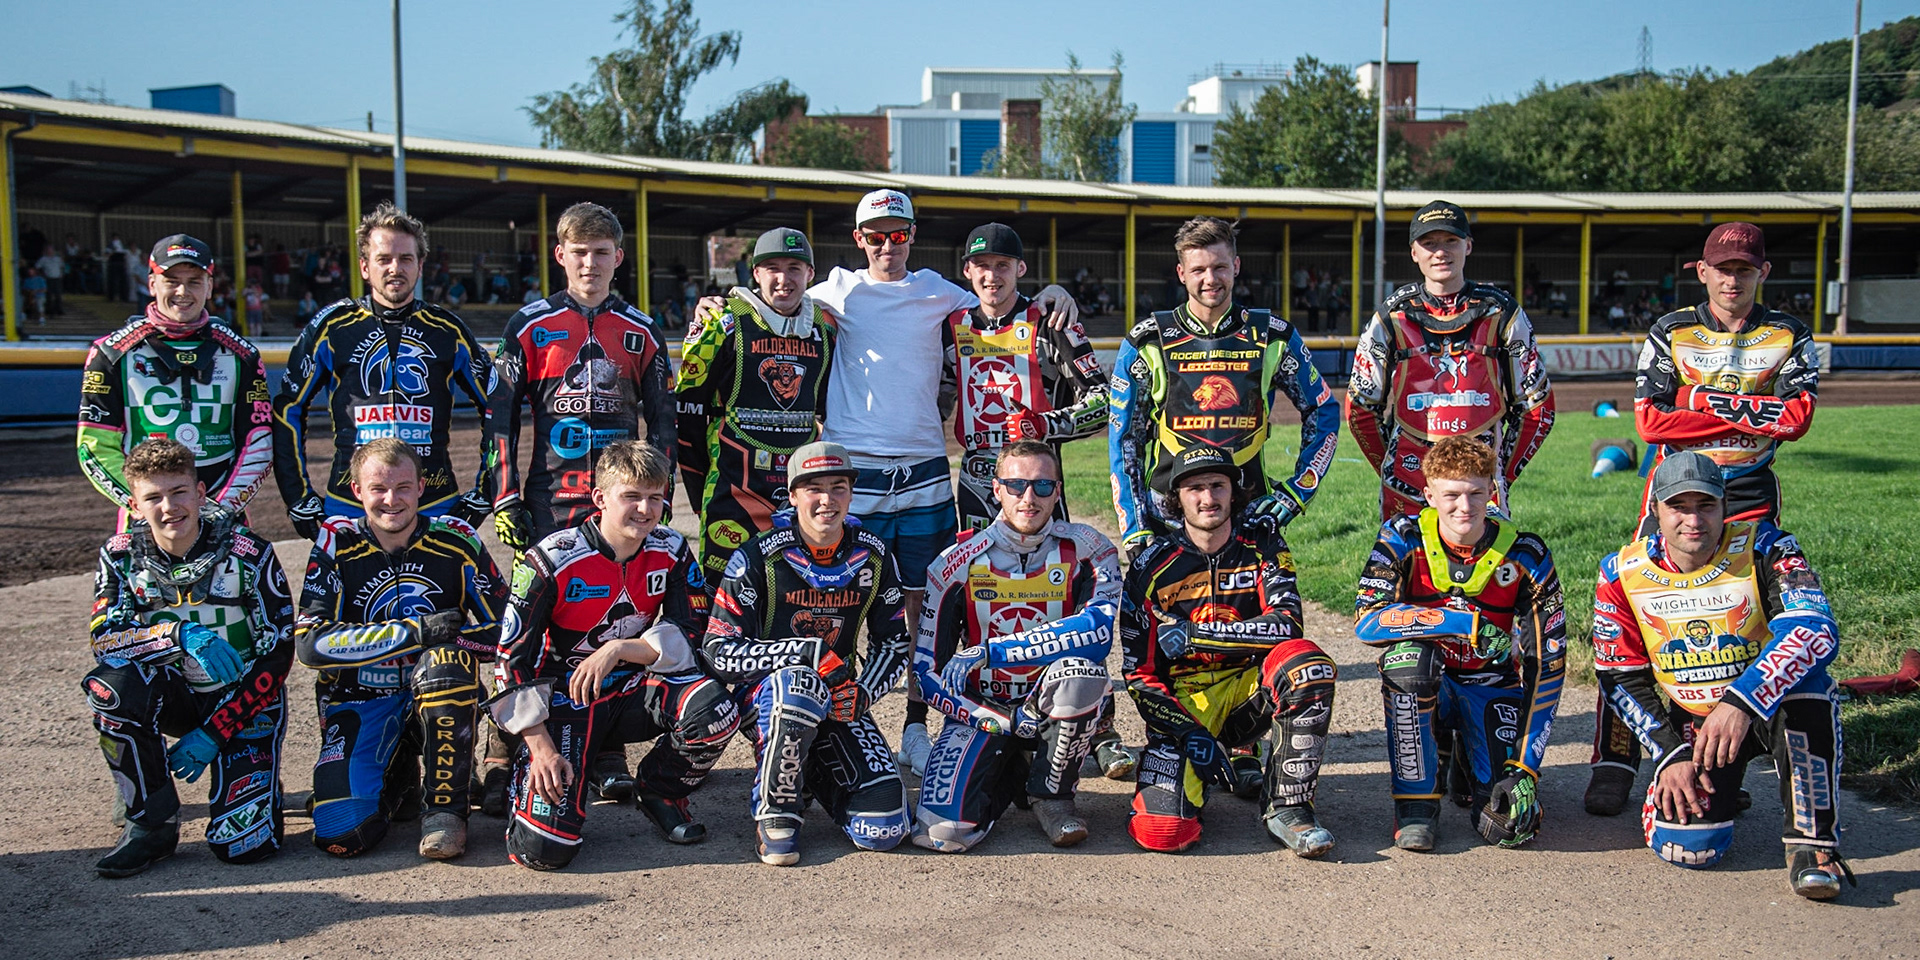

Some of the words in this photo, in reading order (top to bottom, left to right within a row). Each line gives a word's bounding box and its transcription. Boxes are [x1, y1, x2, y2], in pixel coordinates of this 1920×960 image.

[211, 323, 257, 353] cobra's
[1019, 328, 1025, 338] 1
[1692, 329, 1717, 345] ISLE
[1720, 338, 1734, 346] of
[1737, 330, 1773, 347] WIGHT
[751, 337, 818, 358] MILDENHALL
[1170, 351, 1207, 360] ROGER
[1209, 350, 1260, 359] WEBSTER
[1179, 362, 1250, 373] LEICESTER
[1693, 354, 1767, 366] WIGHTLINK
[981, 386, 1005, 396] 2019
[1422, 390, 1491, 408] TouchTec
[357, 406, 433, 423] JARVIS
[1076, 408, 1107, 426] ROCK
[1172, 416, 1215, 430] LION
[1218, 415, 1258, 430] CUBS
[359, 424, 430, 441] nuclear
[1427, 416, 1467, 434] Kings
[1719, 438, 1758, 449] EPOS
[1184, 449, 1222, 460] STAVA
[759, 530, 793, 549] HAGON
[761, 536, 796, 556] SHOCKS
[858, 535, 886, 556] SHOCKS
[859, 530, 885, 549] HAGON
[942, 538, 989, 582] Snap-on
[946, 541, 973, 565] Dave
[859, 568, 873, 587] 2
[1052, 571, 1062, 584] 2
[1502, 568, 1511, 581] 2
[1640, 567, 1670, 587] ISLE
[1674, 579, 1689, 588] of
[1693, 557, 1732, 587] WIGHT
[785, 588, 861, 608] MILDENHALL
[977, 589, 995, 600] ARR
[999, 590, 1007, 599] A.
[1009, 590, 1017, 599] R.
[1018, 590, 1049, 599] Richards
[1051, 590, 1063, 598] Ltd
[1651, 593, 1733, 611] WIGHTLINK
[1029, 630, 1056, 645] on
[1198, 622, 1292, 636] EUROPEAN
[328, 646, 346, 655] CAR
[348, 643, 379, 654] SALES
[717, 641, 808, 658] HAGON
[1006, 625, 1111, 663] Roofing
[1757, 626, 1816, 679] JANE
[430, 646, 473, 674] Mr.Q
[714, 655, 802, 673] SHOCKS
[1061, 656, 1088, 669] LT
[1655, 641, 1763, 672] WARRIORS
[1048, 666, 1106, 682] ELECTRICAL
[1294, 663, 1334, 684] JCB
[1674, 664, 1746, 684] SPEEDWAY
[1755, 625, 1836, 708] HARVEY
[1677, 688, 1707, 702] SBS
[714, 699, 733, 717] The
[929, 693, 971, 726] J.D.R
[1610, 684, 1661, 733] TONY
[1394, 693, 1418, 780] KARTING
[434, 715, 456, 805] GRANDAD
[1142, 755, 1180, 776] COBRAS
[935, 746, 962, 804] CYCLES
[1785, 728, 1817, 838] BARRETT
[1811, 753, 1830, 811] ANN
